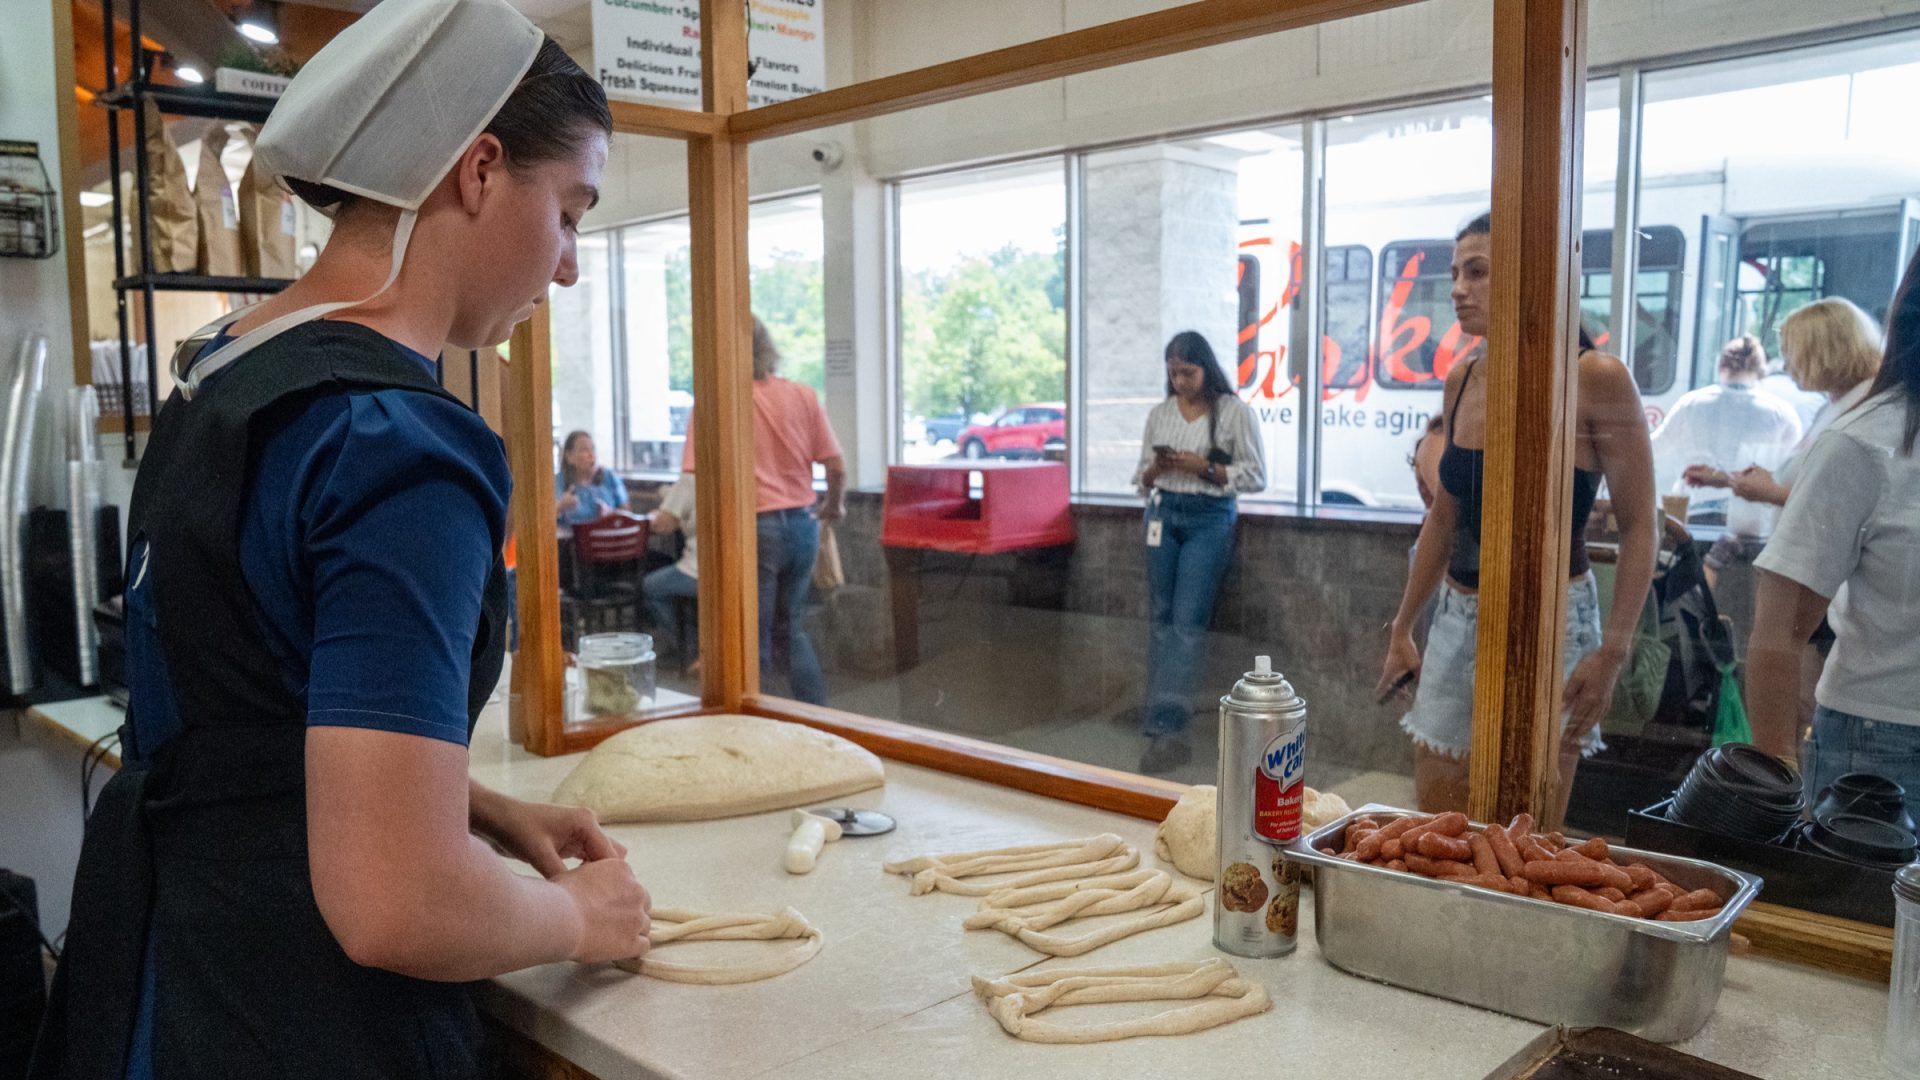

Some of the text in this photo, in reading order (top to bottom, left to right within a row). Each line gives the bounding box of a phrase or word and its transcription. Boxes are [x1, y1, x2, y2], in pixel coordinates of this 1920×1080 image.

[682, 25, 700, 39] Ra
[627, 36, 800, 74] Individual Flavors
[600, 69, 637, 89] Fresh
[640, 78, 699, 95] Squeezed
[617, 58, 674, 75] Delicious
[750, 79, 788, 92] rmelon
[1260, 404, 1431, 434] we ake agin
[1267, 731, 1304, 770] Whit
